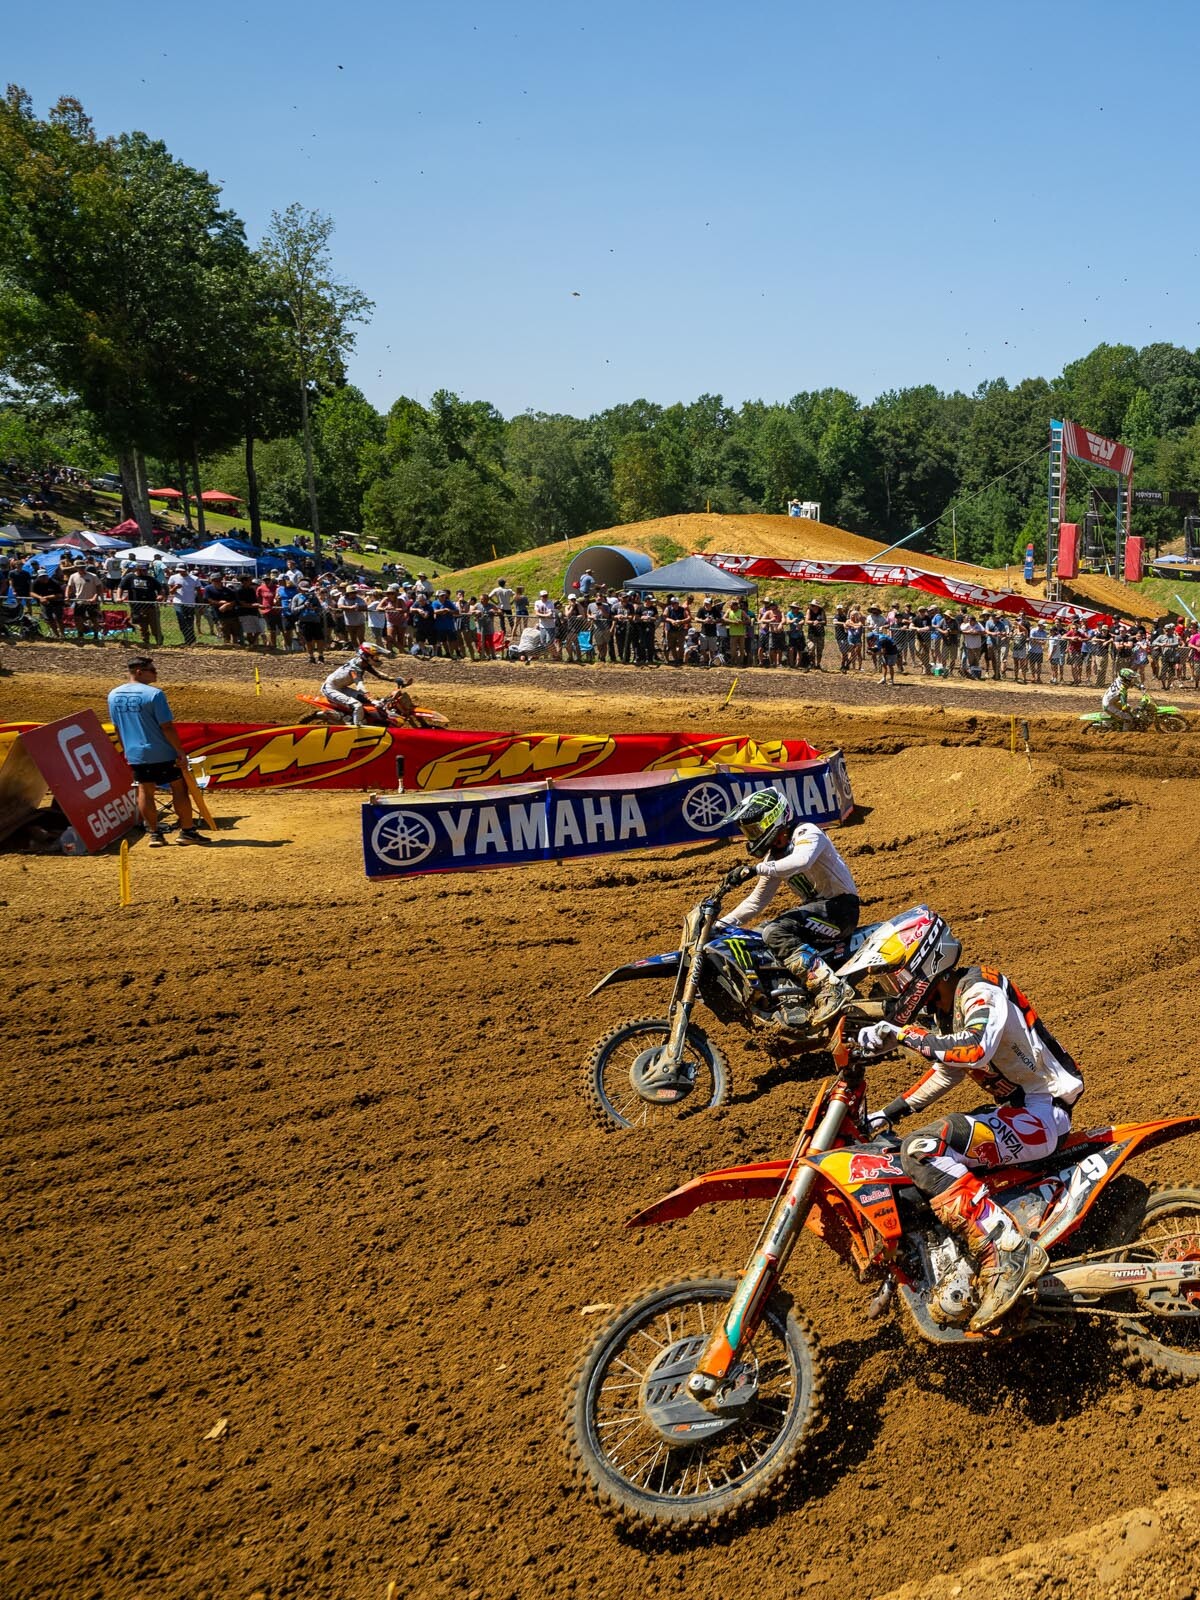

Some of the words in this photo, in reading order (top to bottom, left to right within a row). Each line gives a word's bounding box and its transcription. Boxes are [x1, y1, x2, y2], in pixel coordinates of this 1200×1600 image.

[1086, 432, 1117, 460] FLY
[774, 560, 842, 575] FLY
[859, 564, 926, 581] FLY
[941, 578, 1008, 604] FLY
[87, 789, 137, 839] GASGA
[437, 794, 647, 857] YAMAHA
[804, 918, 840, 938] THOR
